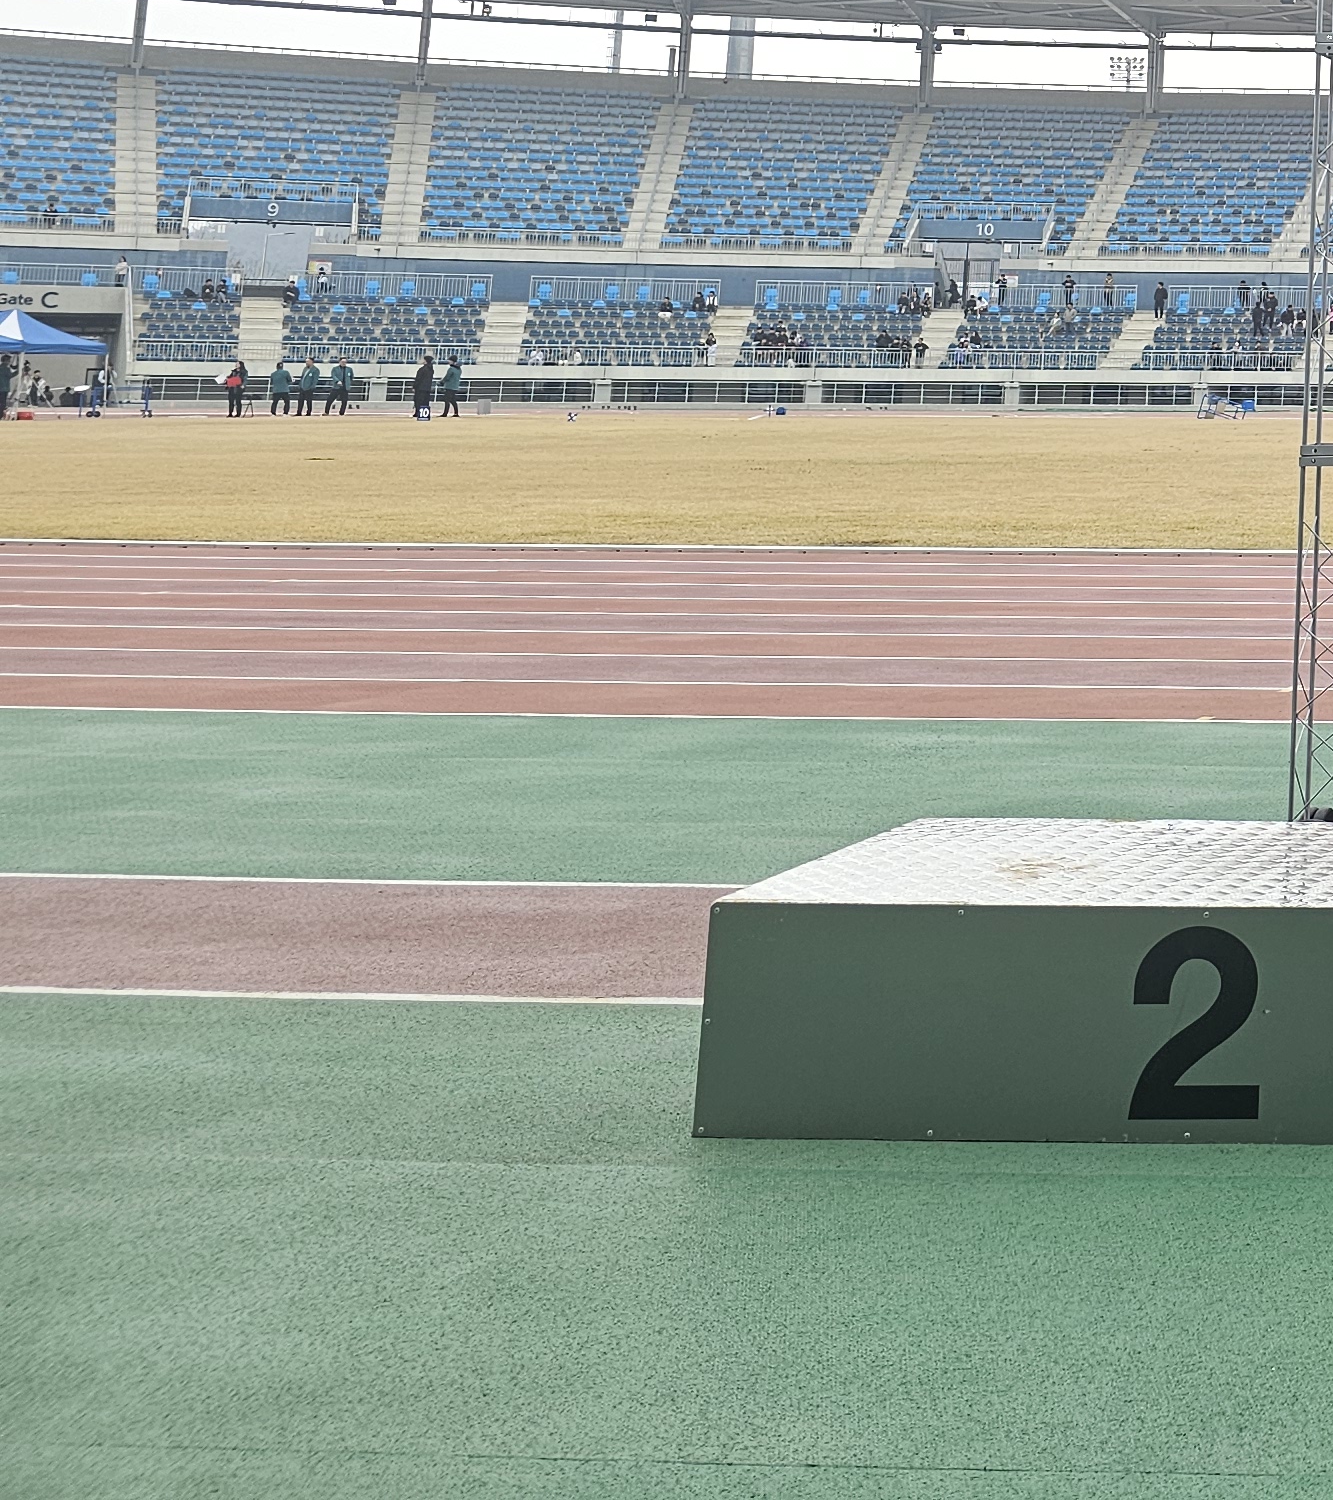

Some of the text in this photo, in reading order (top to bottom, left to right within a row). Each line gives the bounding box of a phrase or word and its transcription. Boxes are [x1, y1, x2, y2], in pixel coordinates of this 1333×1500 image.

[267, 203, 279, 217] 9
[976, 223, 994, 236] 10
[0, 291, 59, 309] Gate C
[419, 407, 430, 418] 10
[1128, 925, 1260, 1120] 2
